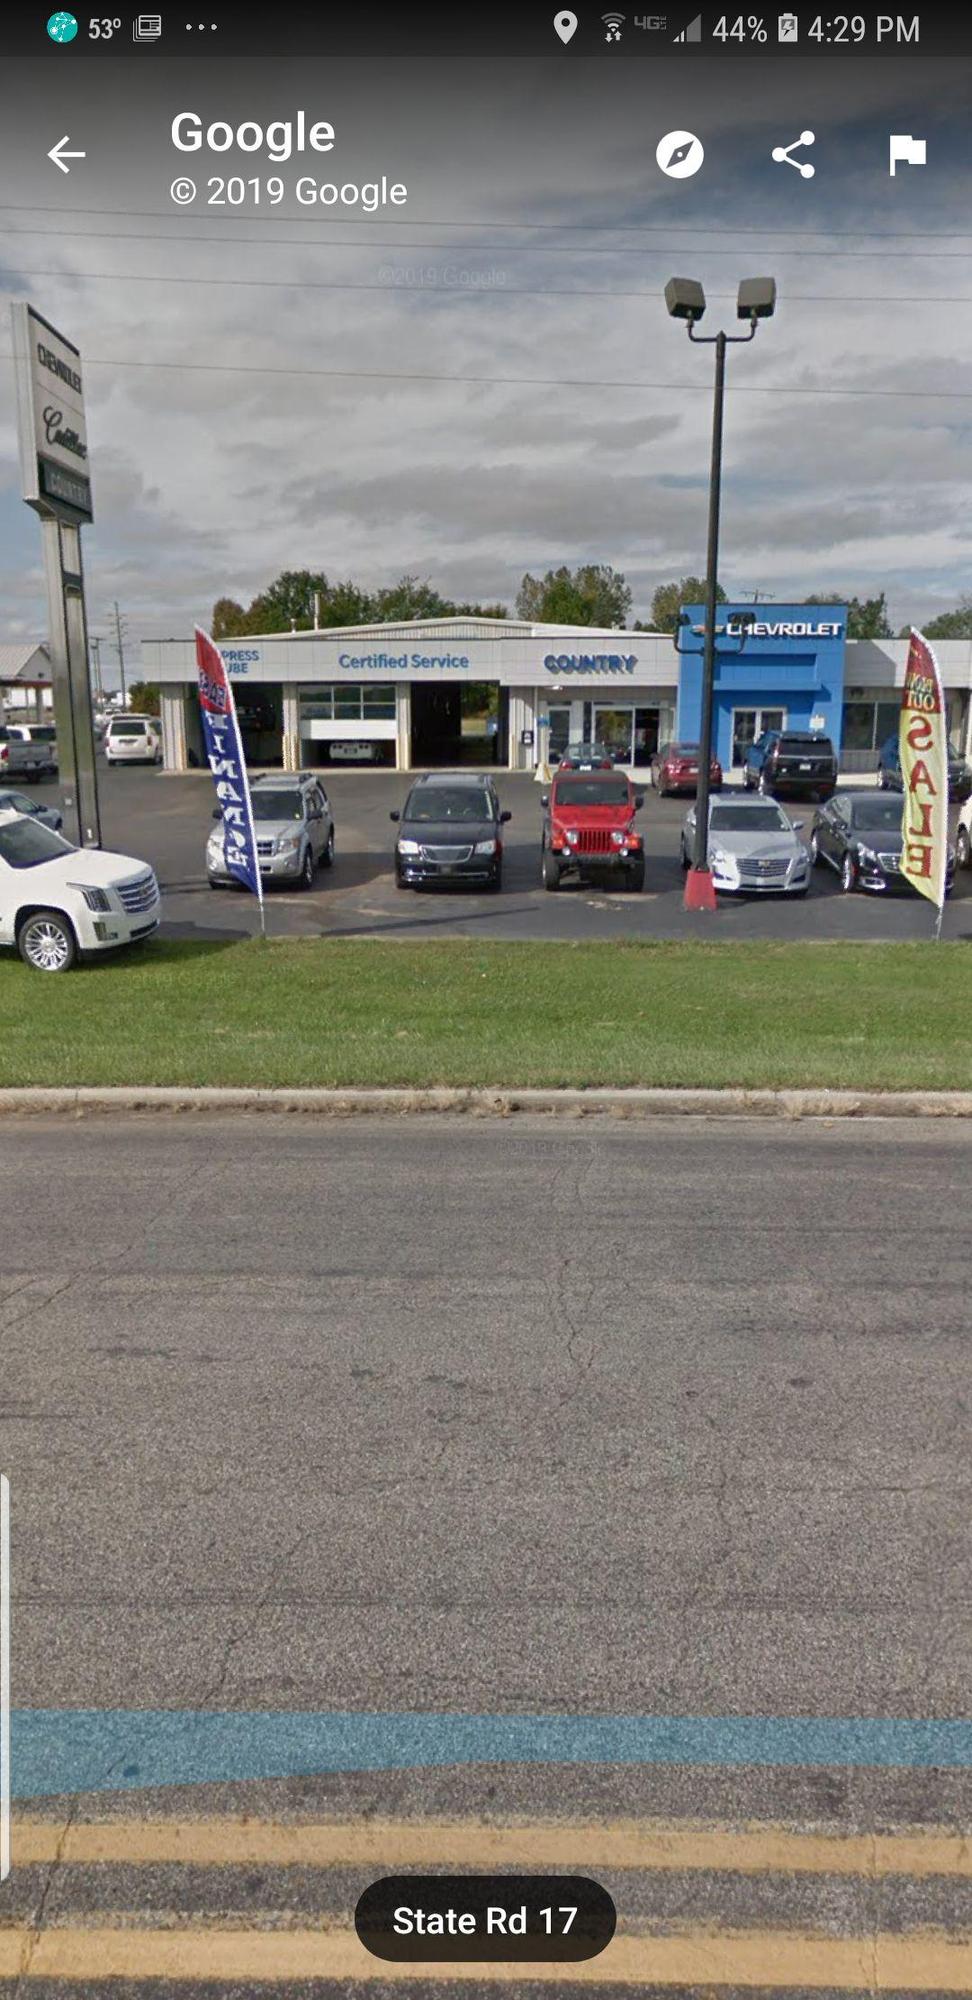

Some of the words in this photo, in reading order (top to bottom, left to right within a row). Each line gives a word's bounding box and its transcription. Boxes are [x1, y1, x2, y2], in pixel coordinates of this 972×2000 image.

[726, 622, 842, 636] CHEVROLET
[221, 650, 260, 661] PRESS
[339, 653, 408, 669] Certified
[411, 653, 469, 669] Service
[228, 662, 249, 674] UBE
[544, 654, 638, 675] COUNTRY
